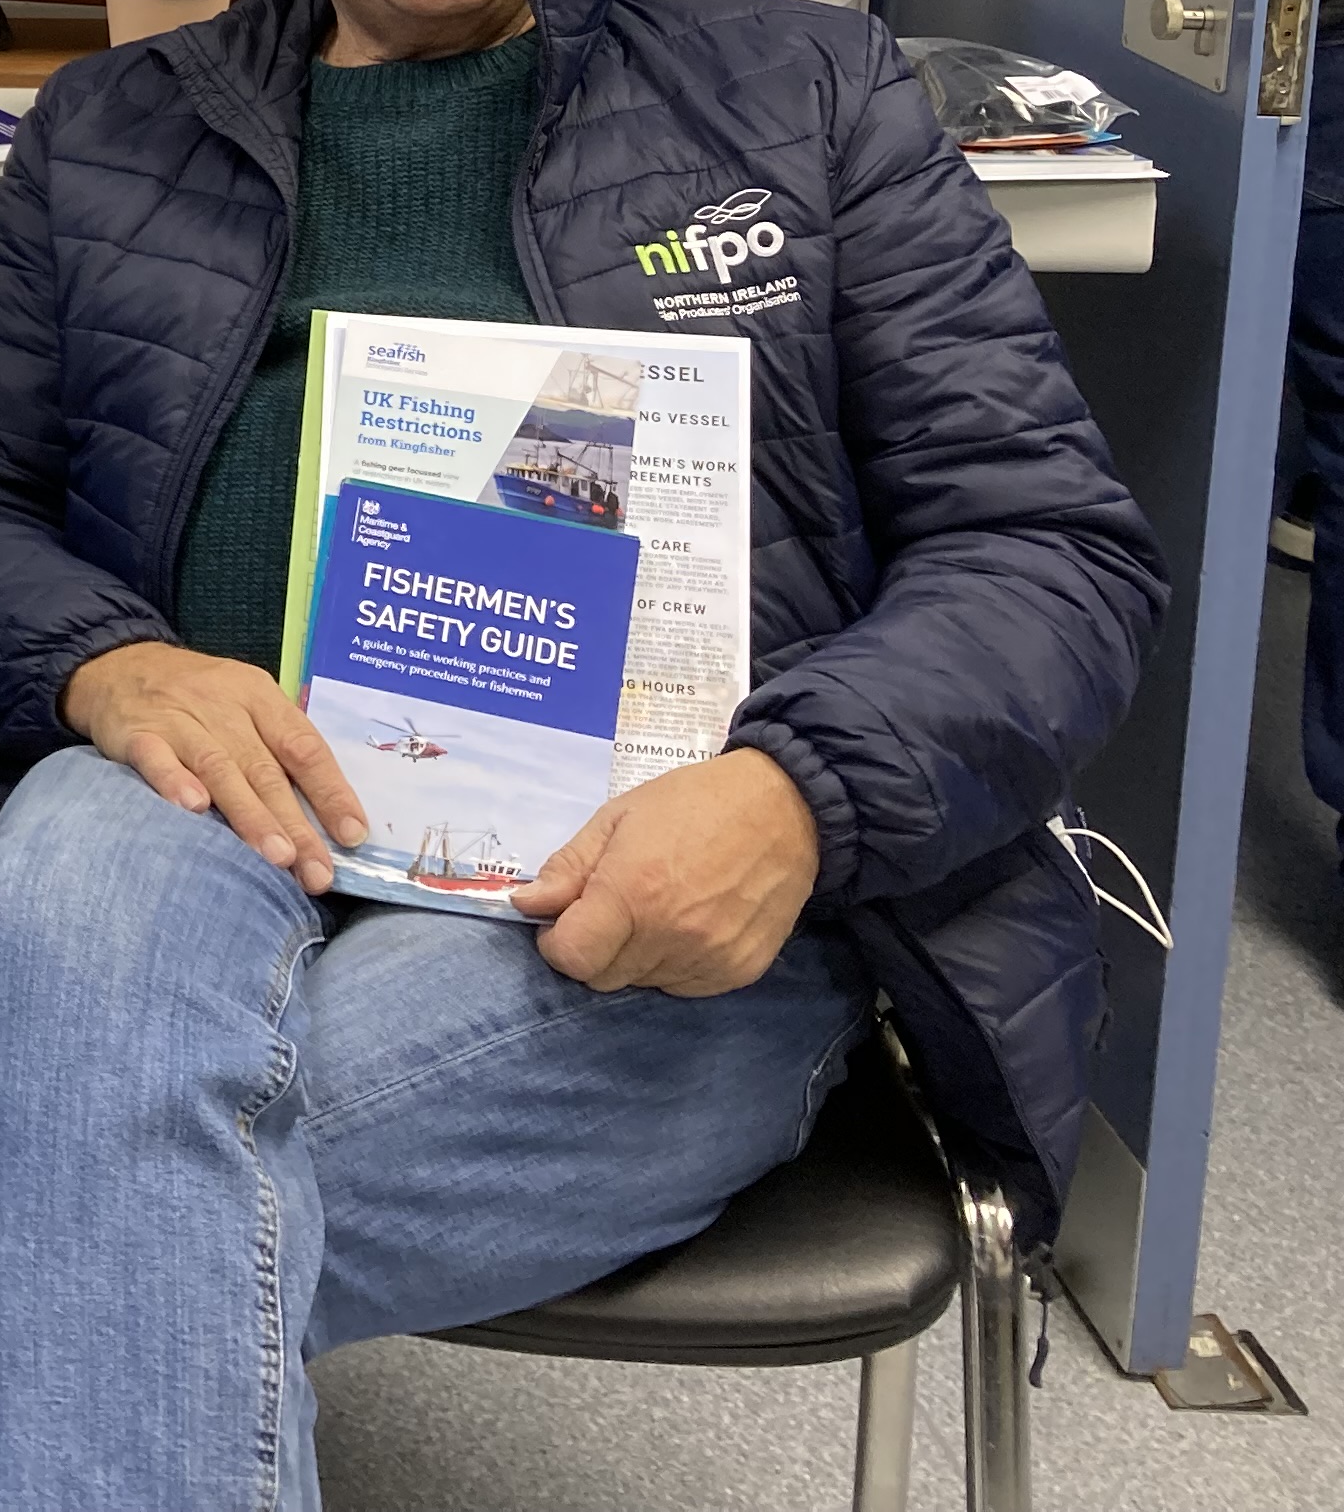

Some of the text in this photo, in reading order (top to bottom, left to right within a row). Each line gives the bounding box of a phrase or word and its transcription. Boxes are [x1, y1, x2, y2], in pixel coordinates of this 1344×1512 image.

[635, 222, 784, 284] nifpo
[654, 276, 798, 310] NORTHERN IRELAND
[732, 291, 801, 315] Organisation
[368, 344, 426, 362] seafish
[364, 390, 475, 424] UK Fishing
[360, 412, 482, 442] Restrictions
[668, 412, 730, 427] VESSEL
[358, 434, 456, 457] from Kingfisher
[692, 460, 736, 472] WORK
[358, 525, 410, 542] Coastguard
[360, 515, 398, 530] Maritime
[356, 535, 390, 550] Agency
[652, 540, 692, 552] CARE
[364, 562, 576, 630] FISHERMEN'S
[638, 599, 706, 614] OF CREW
[356, 600, 476, 648] SAFETY
[480, 627, 579, 670] GUIDE
[352, 636, 551, 686] A guide to safe working practices and
[349, 652, 542, 702] emergency procedures for fishermen
[643, 680, 696, 696] HOURS
